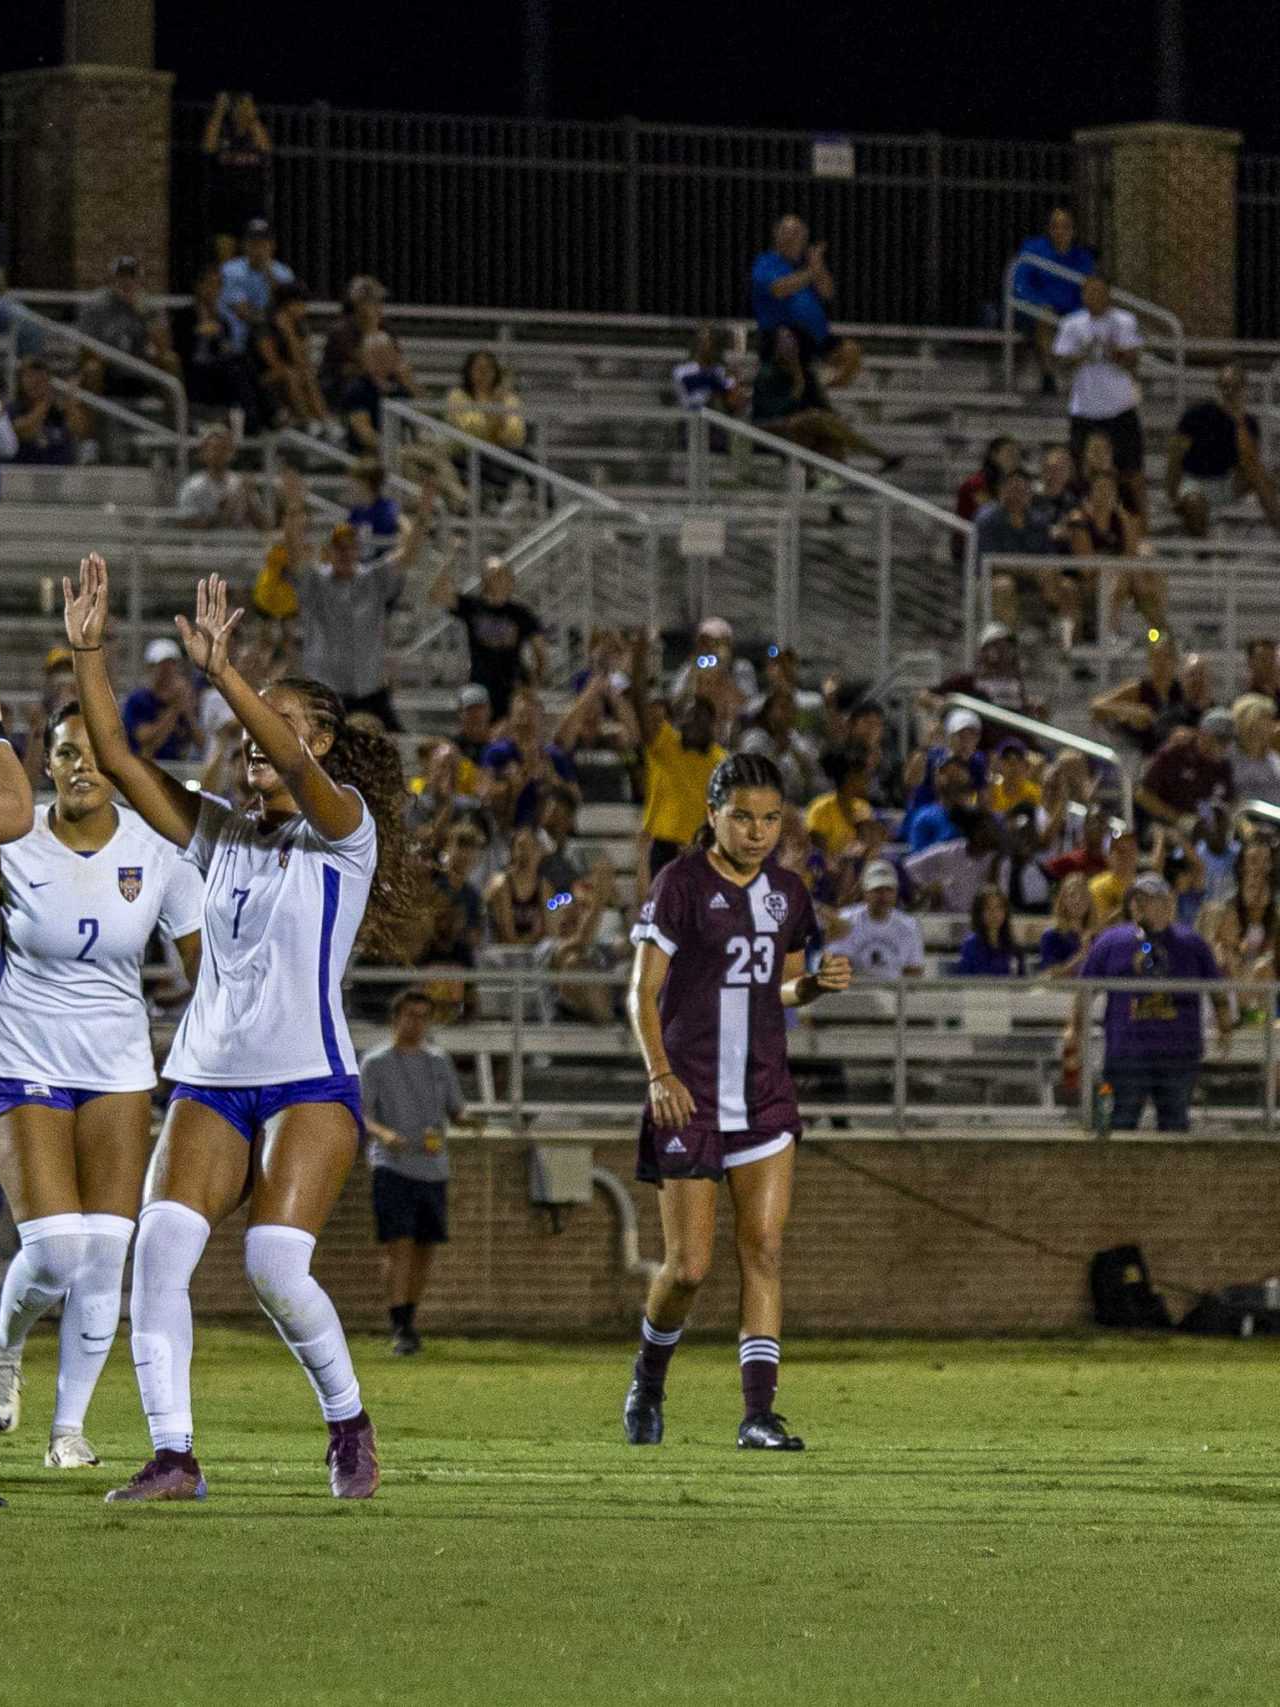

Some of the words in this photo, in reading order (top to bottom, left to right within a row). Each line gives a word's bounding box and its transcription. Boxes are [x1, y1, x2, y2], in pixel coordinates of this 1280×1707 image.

[231, 887, 252, 939] 7
[76, 918, 99, 964] 2
[725, 935, 775, 984] 23
